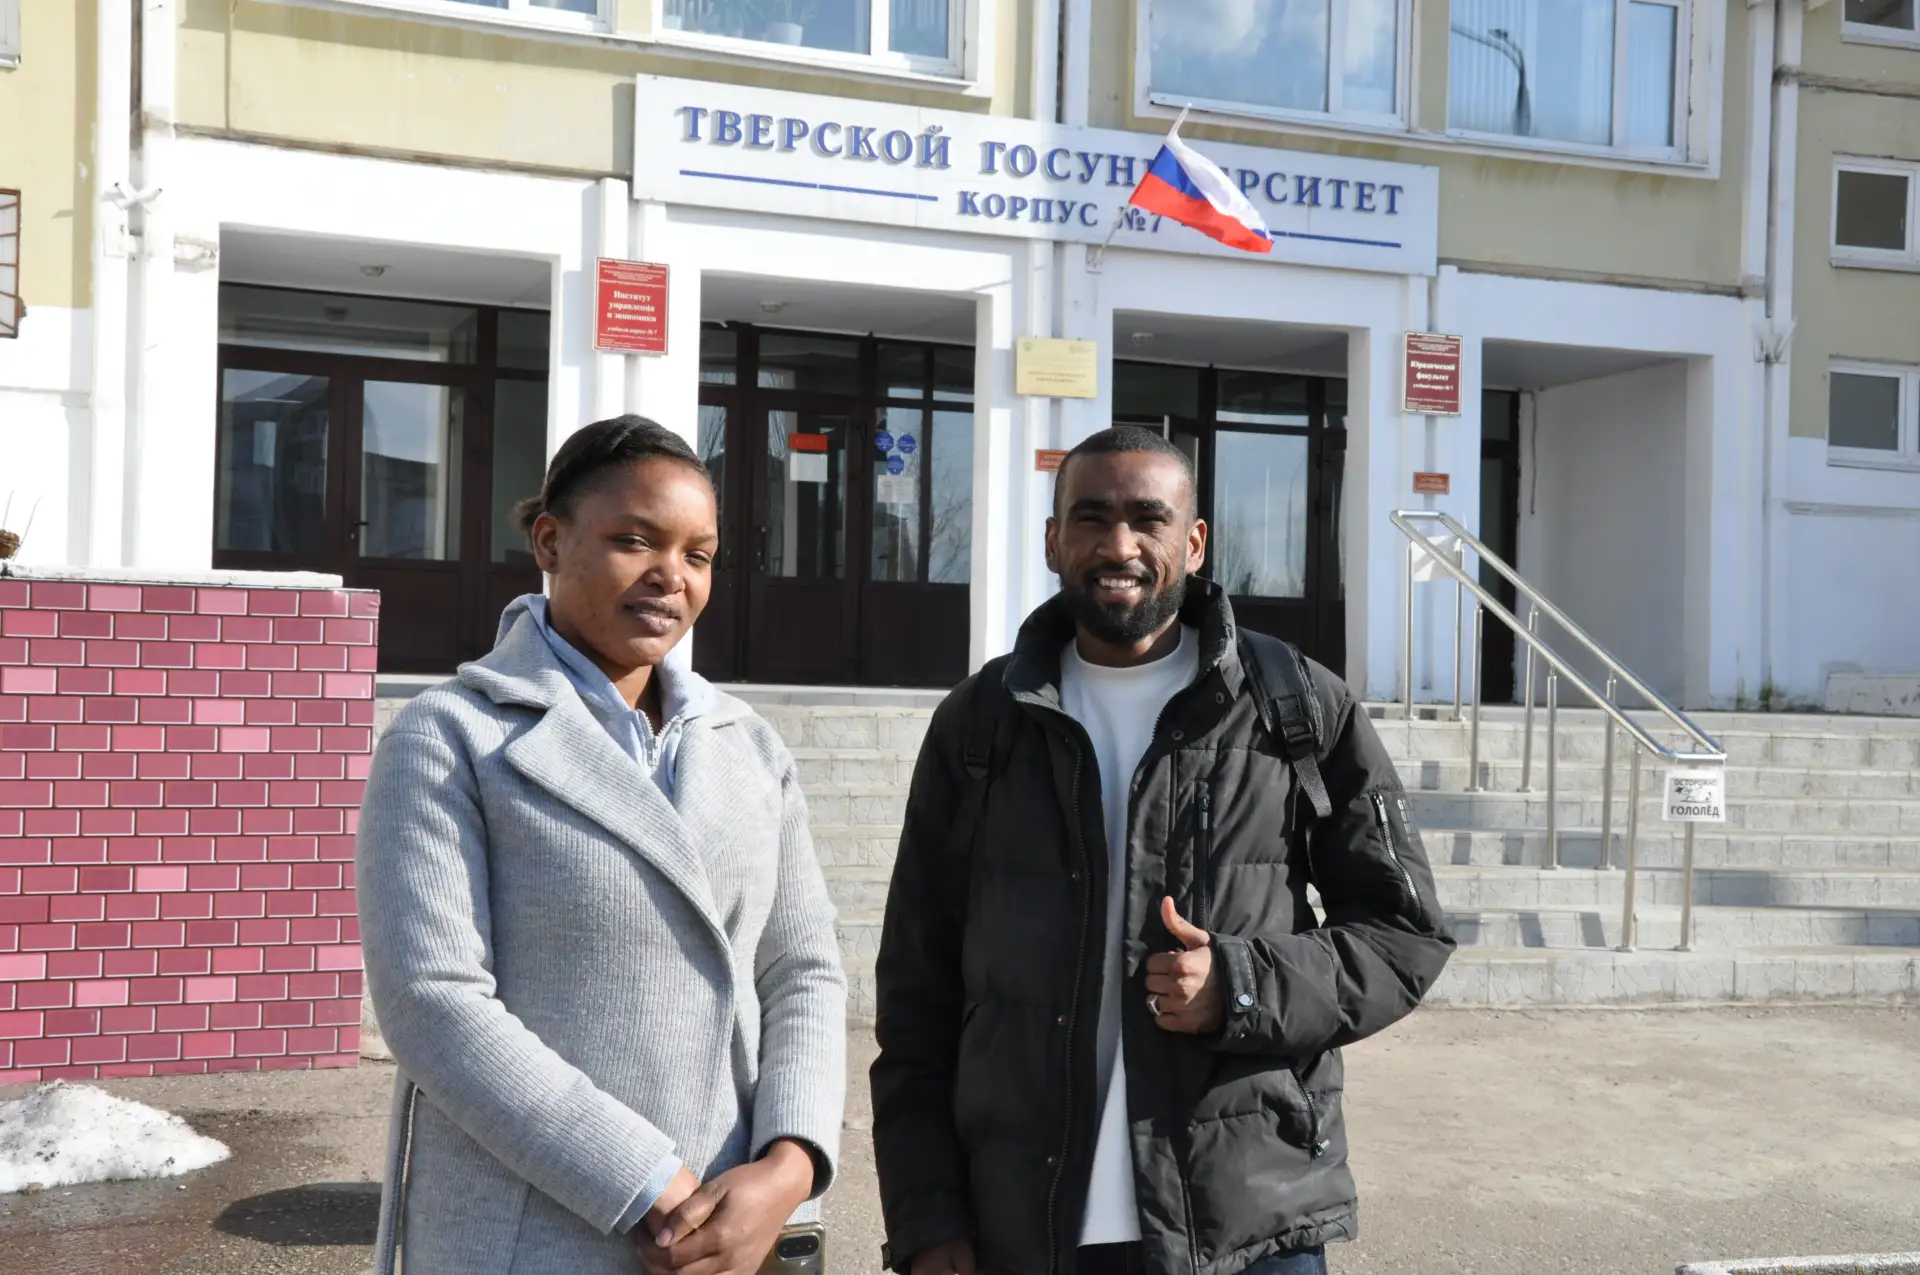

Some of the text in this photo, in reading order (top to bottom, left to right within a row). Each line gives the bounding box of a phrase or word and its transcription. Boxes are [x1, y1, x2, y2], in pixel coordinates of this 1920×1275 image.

[678, 106, 1405, 215] ТВЕРСКОЙ ГОСУНРСИТЕТ
[958, 190, 1099, 228] КОРПУС
[613, 290, 651, 302] Институт
[608, 302, 656, 312] управления
[1410, 360, 1456, 371] Юридический
[1416, 371, 1449, 381] факультет
[1670, 805, 1720, 817] ГОЛОЛЁД
